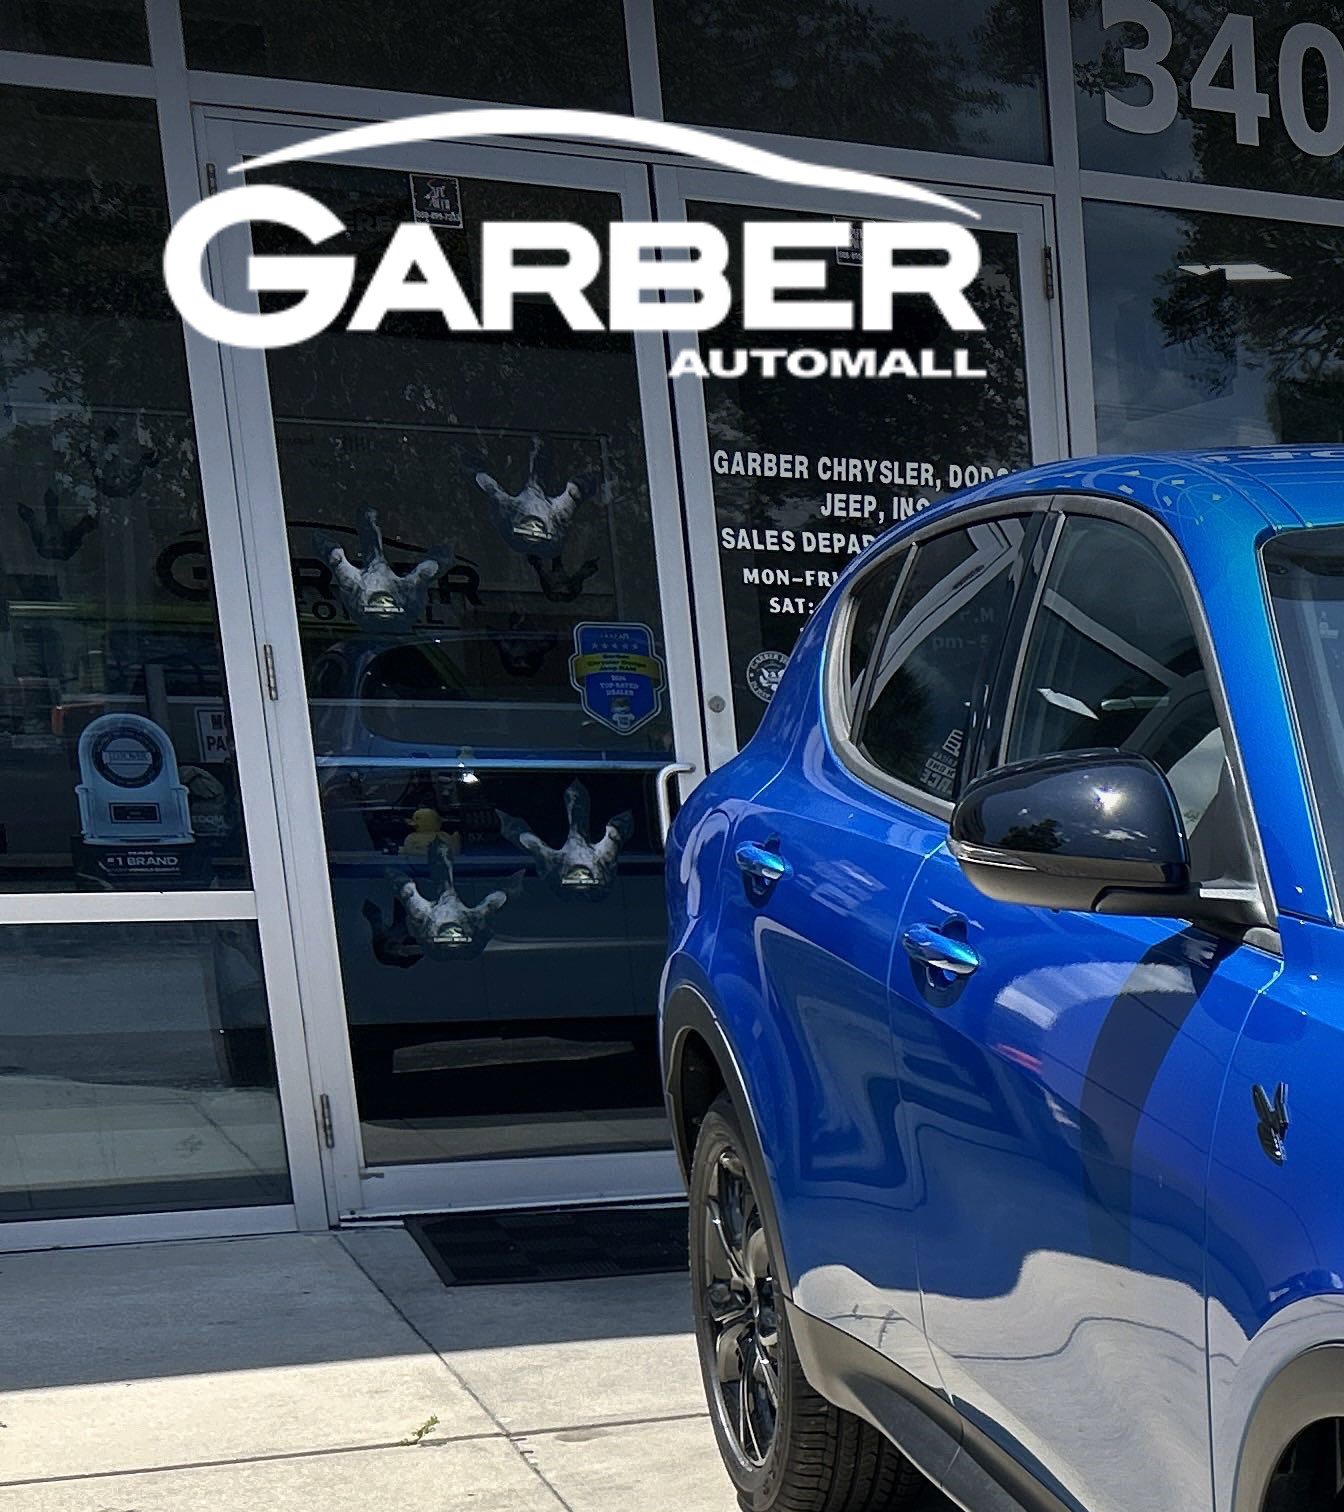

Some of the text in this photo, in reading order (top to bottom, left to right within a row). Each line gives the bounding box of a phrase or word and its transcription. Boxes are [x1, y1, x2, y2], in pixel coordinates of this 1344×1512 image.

[713, 450, 1017, 492] GARBER CHRYSLER, DOD
[821, 492, 885, 524] JEEP,
[721, 528, 796, 552] SALES
[127, 857, 178, 866] BRAND
